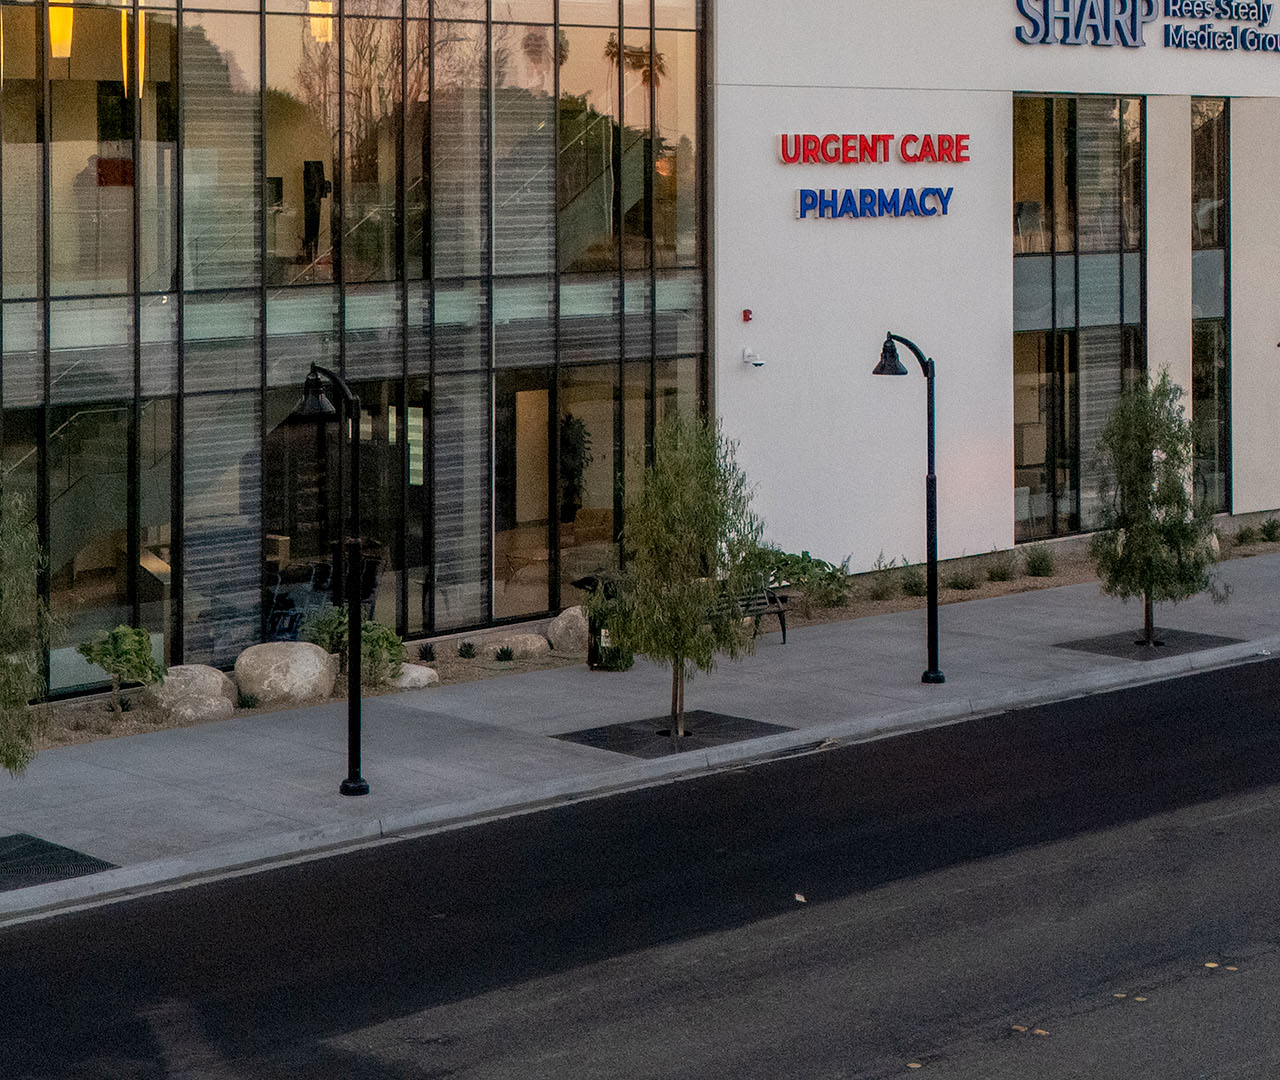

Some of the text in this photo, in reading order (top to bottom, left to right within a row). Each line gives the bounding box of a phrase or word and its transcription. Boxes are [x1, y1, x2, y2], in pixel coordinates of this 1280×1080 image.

[1164, 23, 1240, 50] Medical
[779, 133, 970, 164] URGENT CARE
[797, 186, 954, 219] PHARMACY
